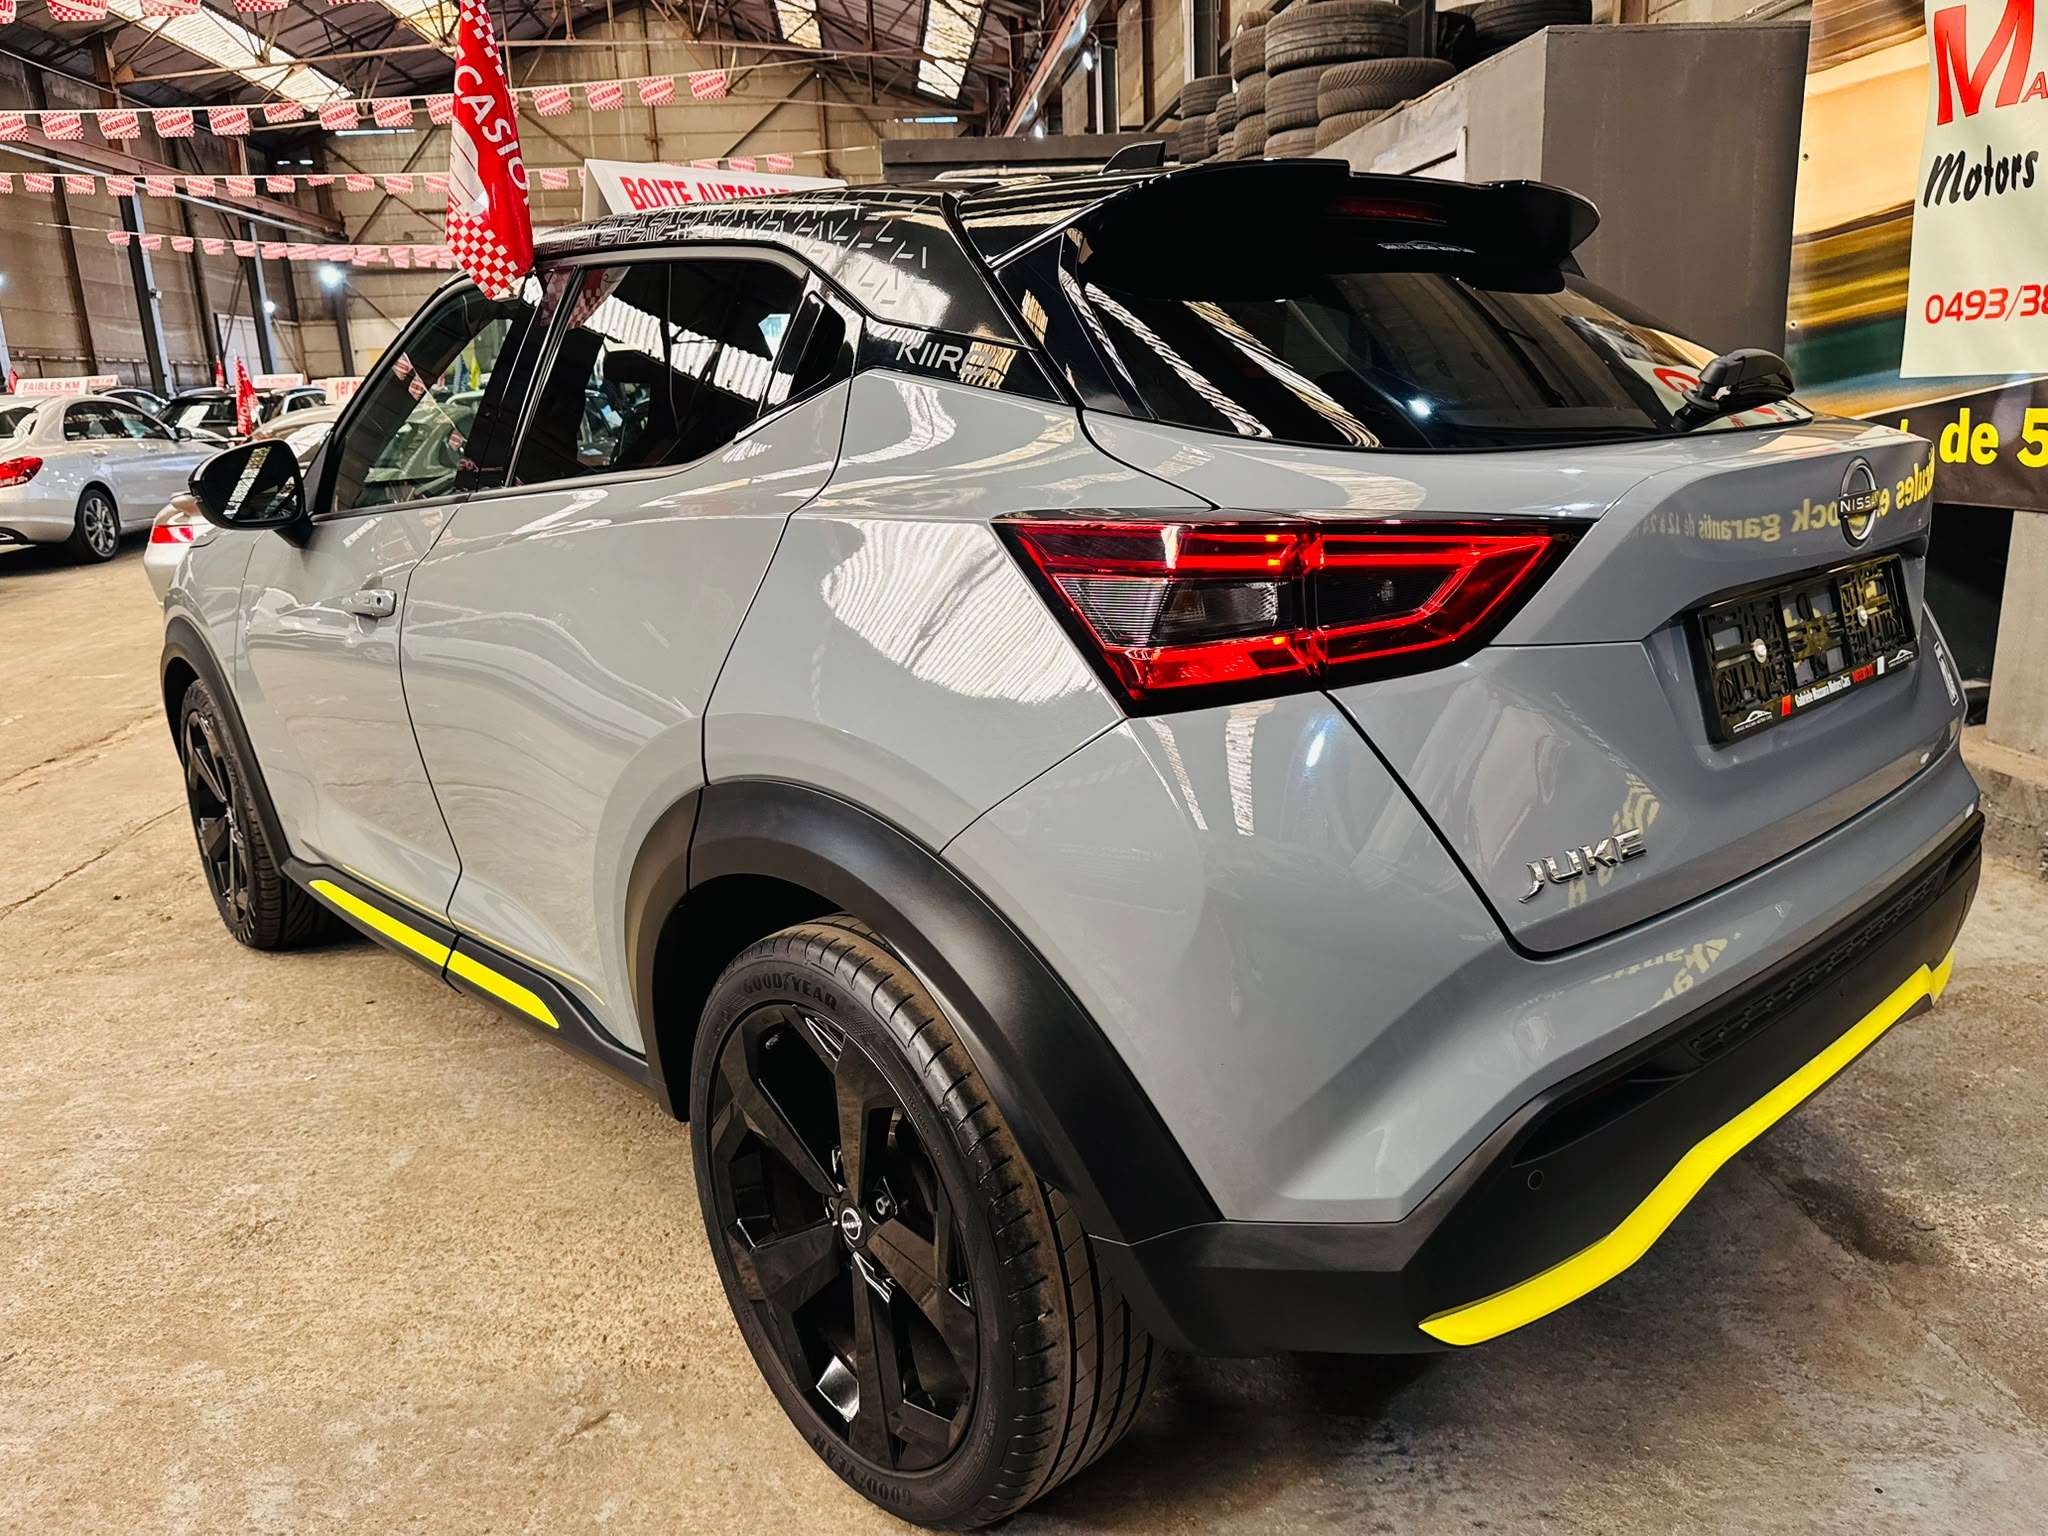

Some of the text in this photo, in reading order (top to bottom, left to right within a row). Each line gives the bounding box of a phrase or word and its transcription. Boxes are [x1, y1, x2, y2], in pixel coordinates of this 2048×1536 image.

[454, 46, 530, 205] CASIO
[620, 176, 693, 210] BOITE
[1923, 144, 2039, 208] Motors
[65, 381, 80, 389] KM
[895, 340, 993, 379] KIIRO
[1940, 407, 2048, 468] de 5
[1518, 827, 1648, 904] JUKE
